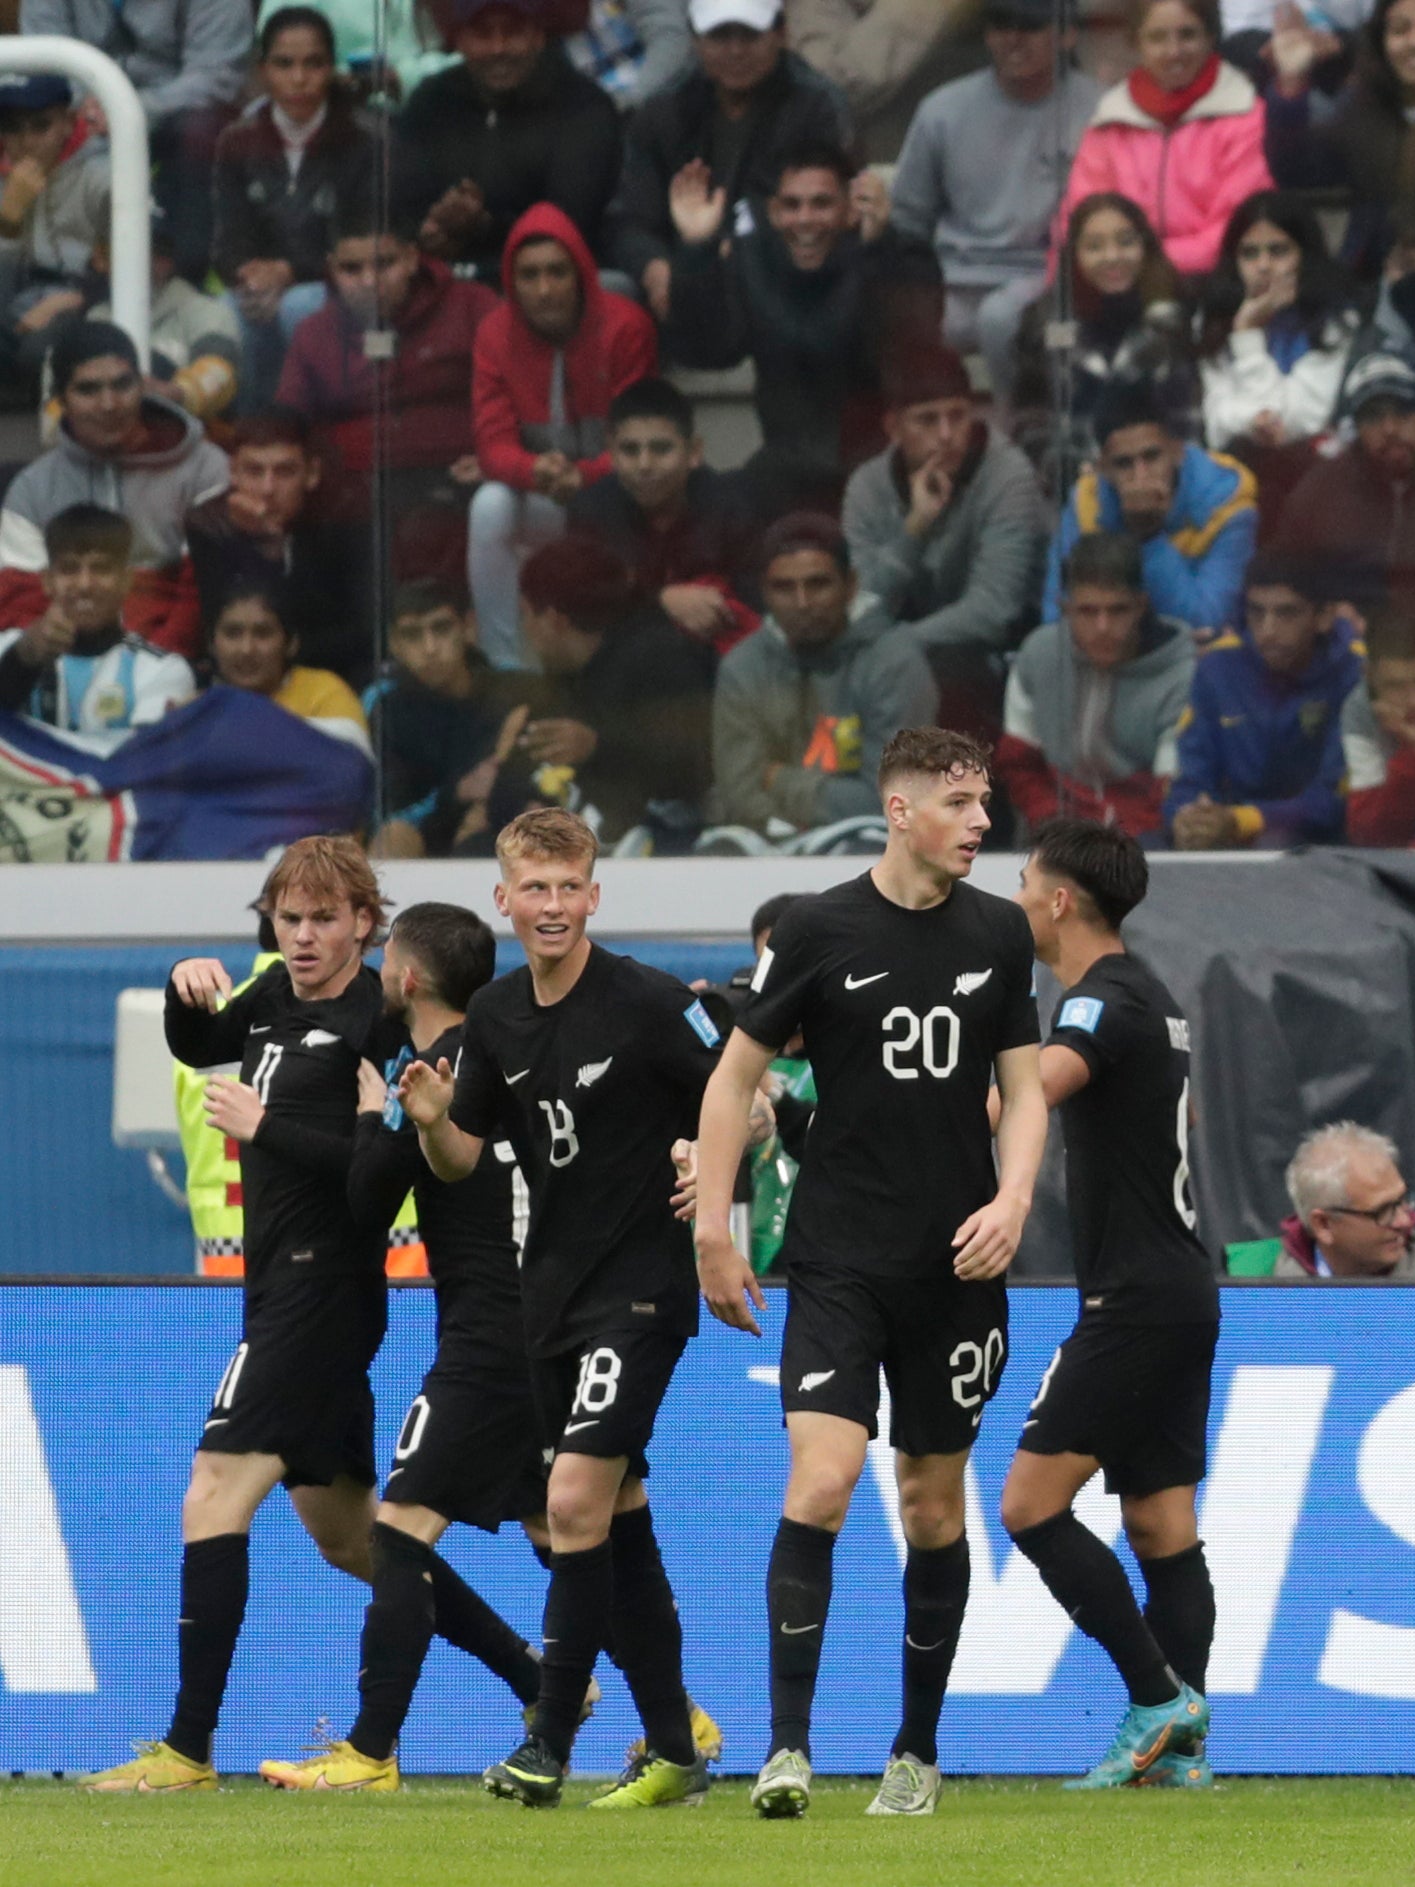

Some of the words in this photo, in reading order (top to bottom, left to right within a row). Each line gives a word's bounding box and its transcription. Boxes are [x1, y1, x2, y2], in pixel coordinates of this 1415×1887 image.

[882, 1006, 960, 1079] 20
[571, 1347, 622, 1415] 18
[950, 1328, 1004, 1409] 20
